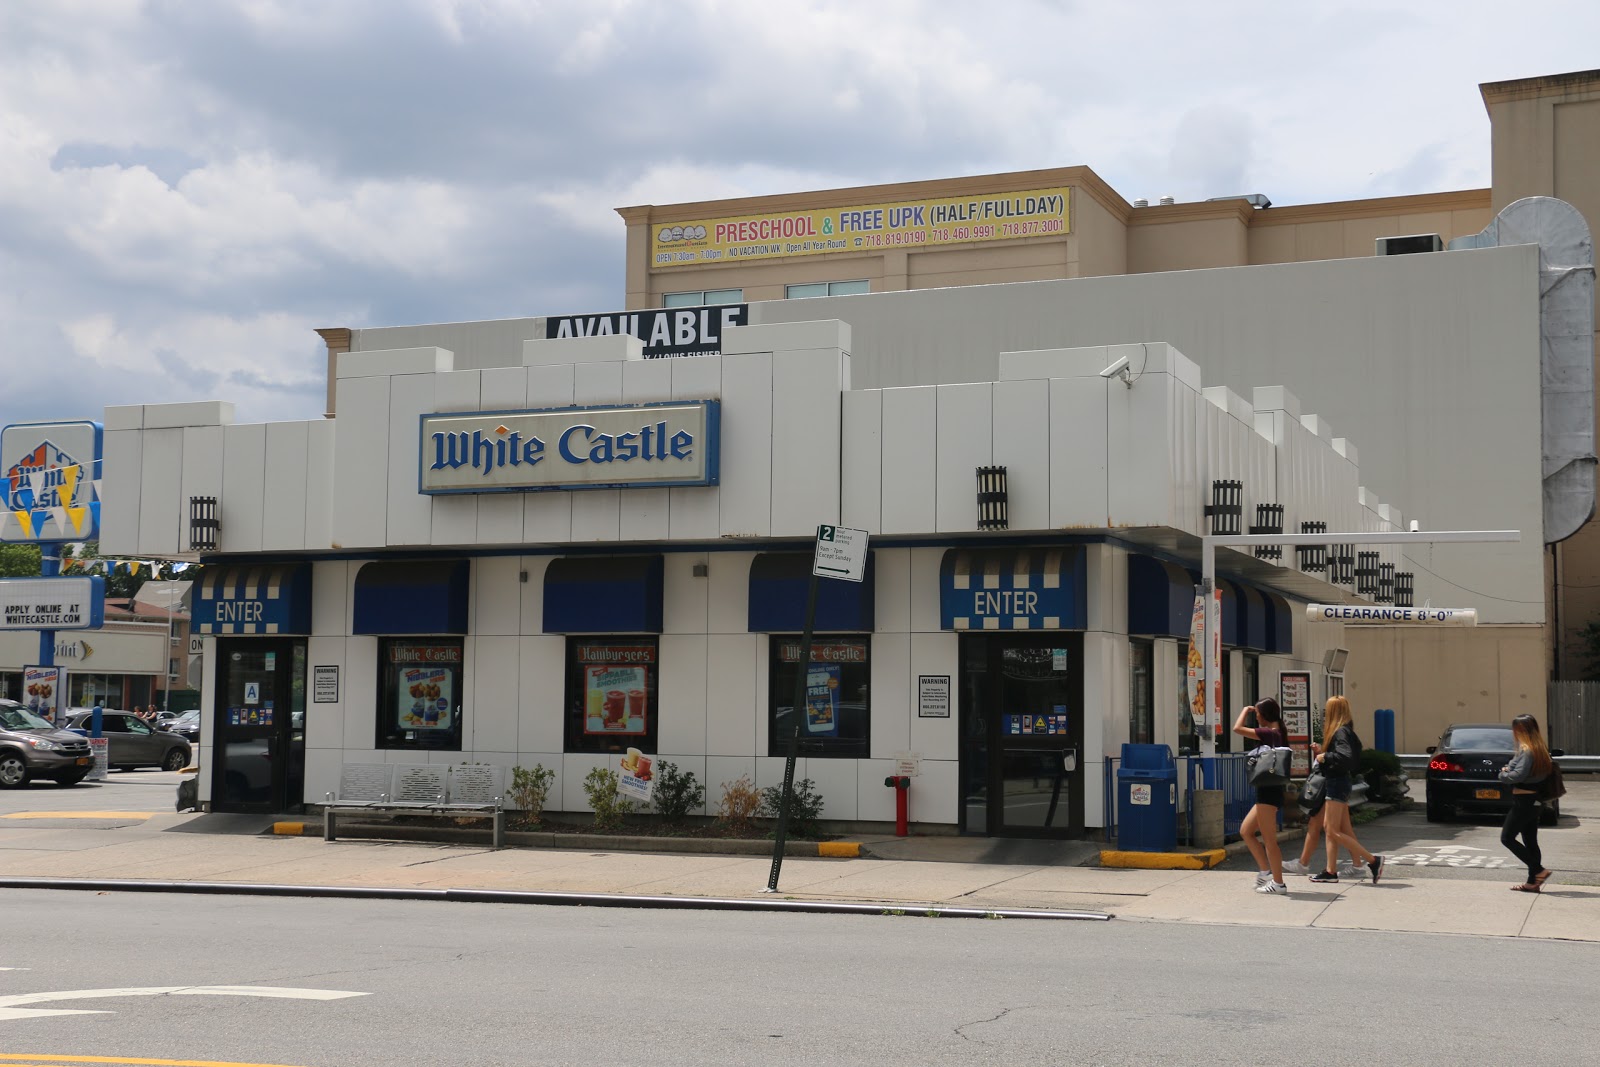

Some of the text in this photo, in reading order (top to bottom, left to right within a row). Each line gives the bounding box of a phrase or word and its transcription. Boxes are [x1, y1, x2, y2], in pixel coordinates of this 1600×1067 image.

[715, 195, 1064, 243] PRESCHOOL & FREE UPK (HALF/FULLDAY)
[865, 219, 1064, 247] 718.819.0190 718.460.9991 718.877.3001
[656, 253, 672, 263] OPEN
[673, 251, 695, 262] 7:30am
[700, 249, 722, 260] 7:00pm
[729, 248, 738, 257] NO
[739, 245, 769, 256] VACATION
[770, 244, 781, 253] WK
[786, 243, 801, 253] Open
[802, 241, 811, 250] All
[812, 240, 826, 250] Year
[827, 239, 847, 249] Round
[430, 420, 694, 476] White Castle
[823, 527, 832, 540] 2
[819, 552, 851, 562] Except Sunday
[5, 604, 80, 614] APPLY ONLINE AT
[974, 591, 1039, 615] ENTER
[6, 614, 80, 624] WHITECASTLE.COM
[216, 601, 263, 622] ENTER
[1324, 607, 1412, 621] CLEARANCE
[394, 646, 458, 662] White Castle
[583, 647, 650, 662] Hamburgers
[822, 646, 860, 661] Castle
[246, 685, 257, 698] A
[808, 686, 830, 696] FREE
